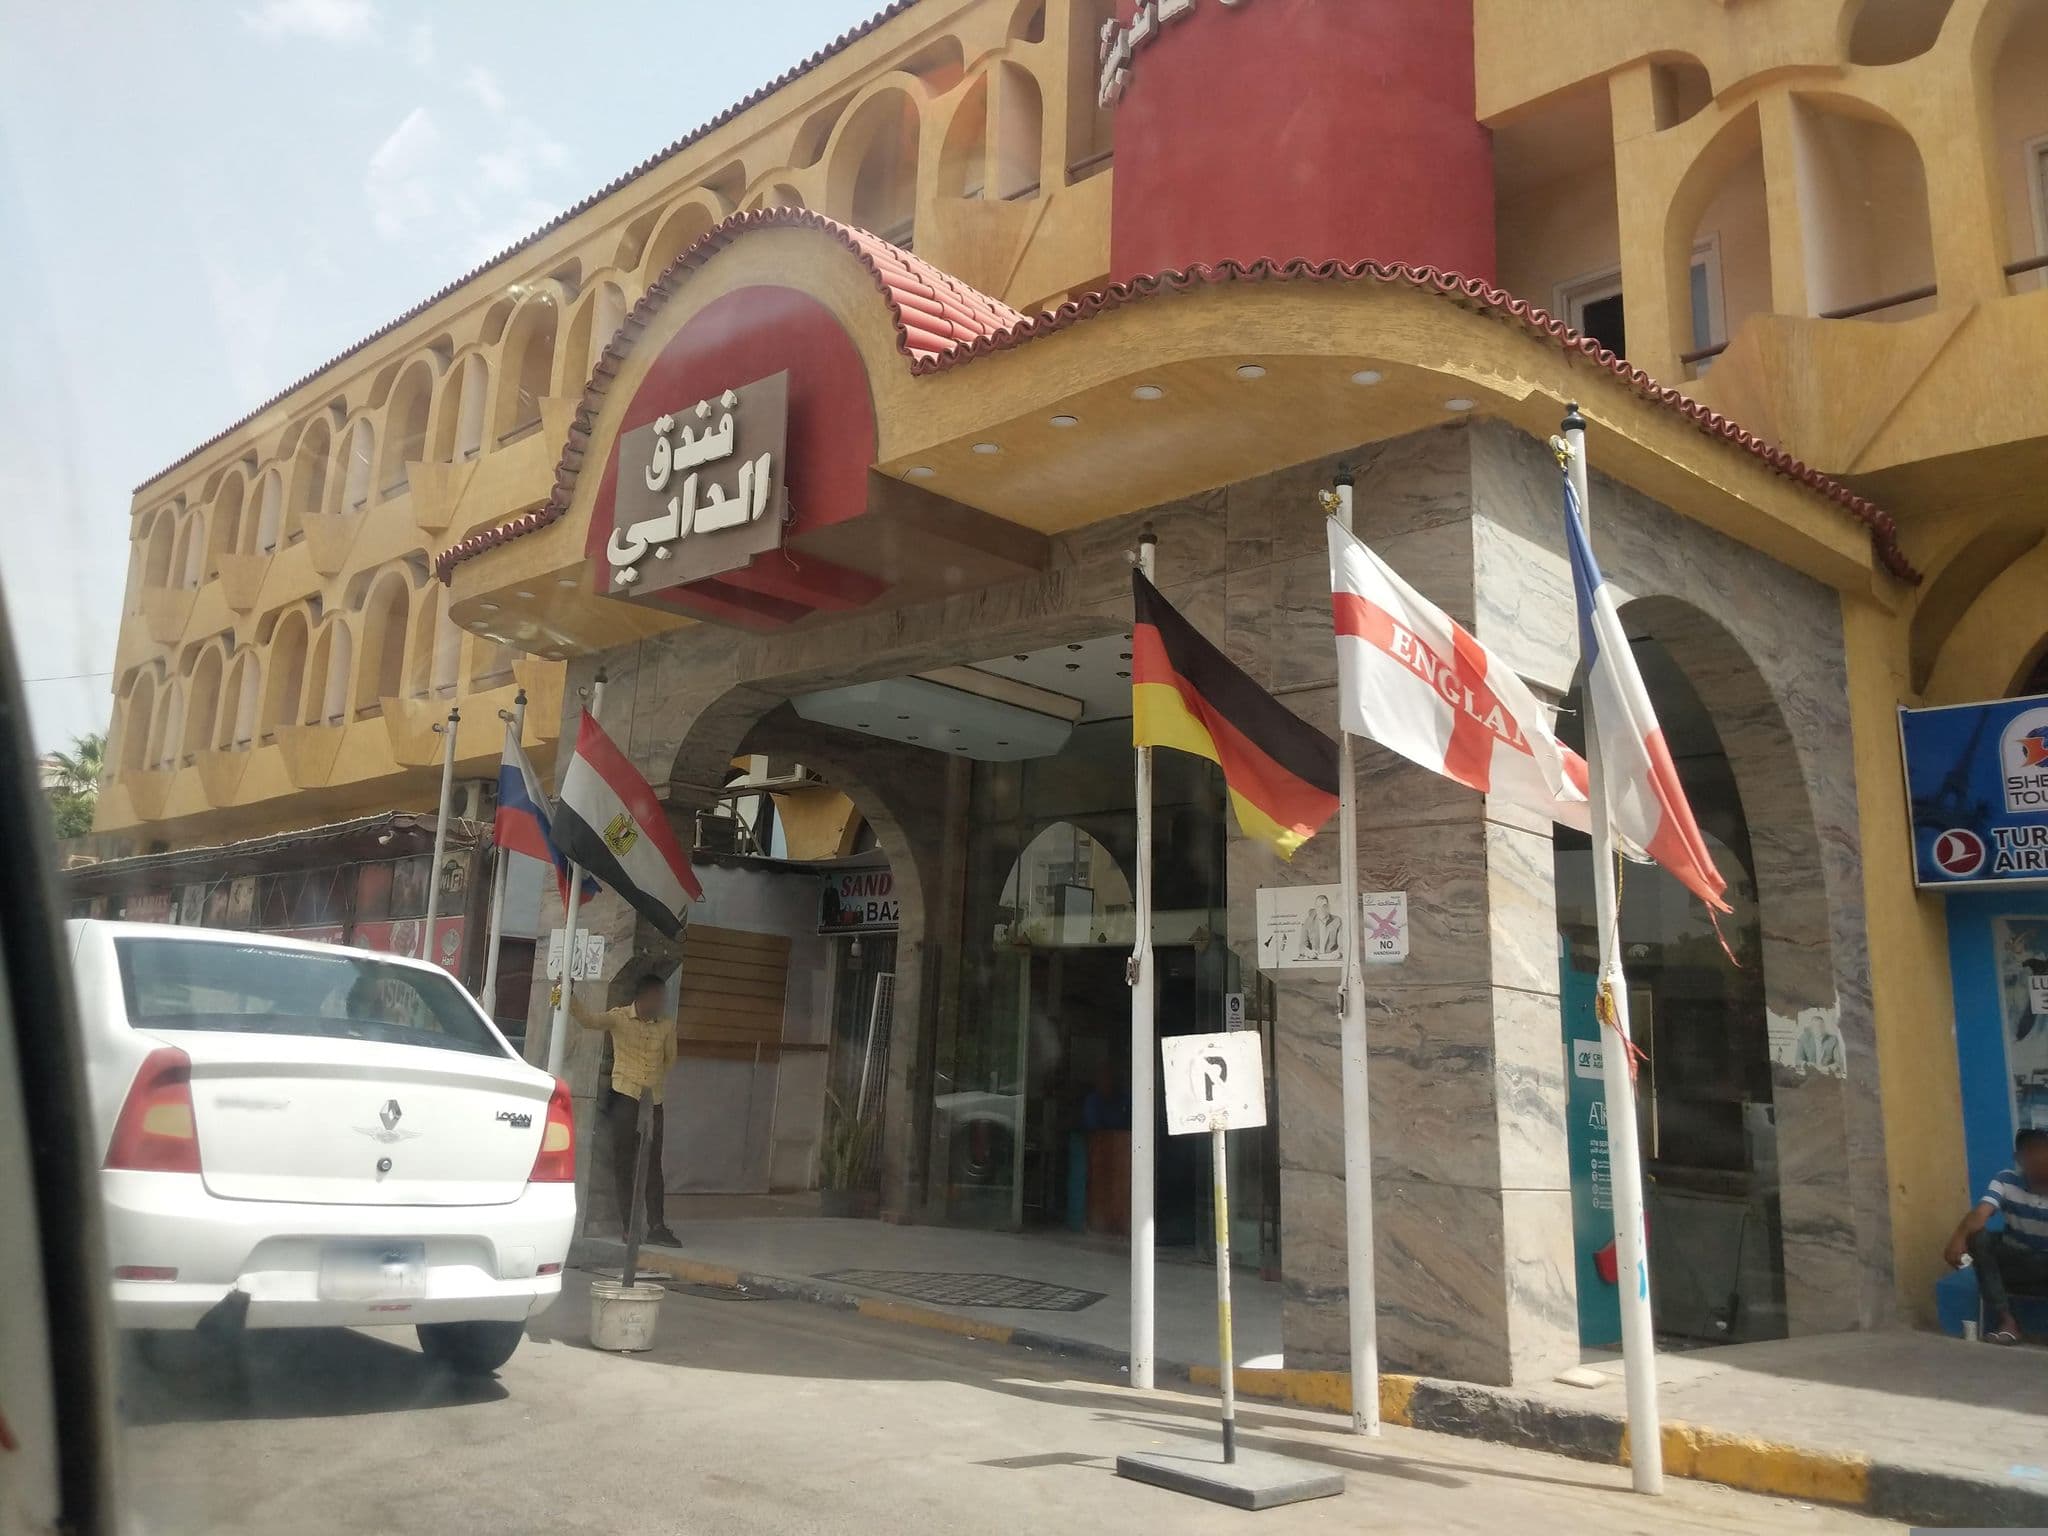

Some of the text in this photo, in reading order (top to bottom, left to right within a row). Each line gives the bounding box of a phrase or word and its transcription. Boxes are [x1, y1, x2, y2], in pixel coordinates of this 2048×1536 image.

[645, 389, 738, 491] فندق
[1380, 940, 1393, 949] NO
[495, 1110, 533, 1122] LOGAN
